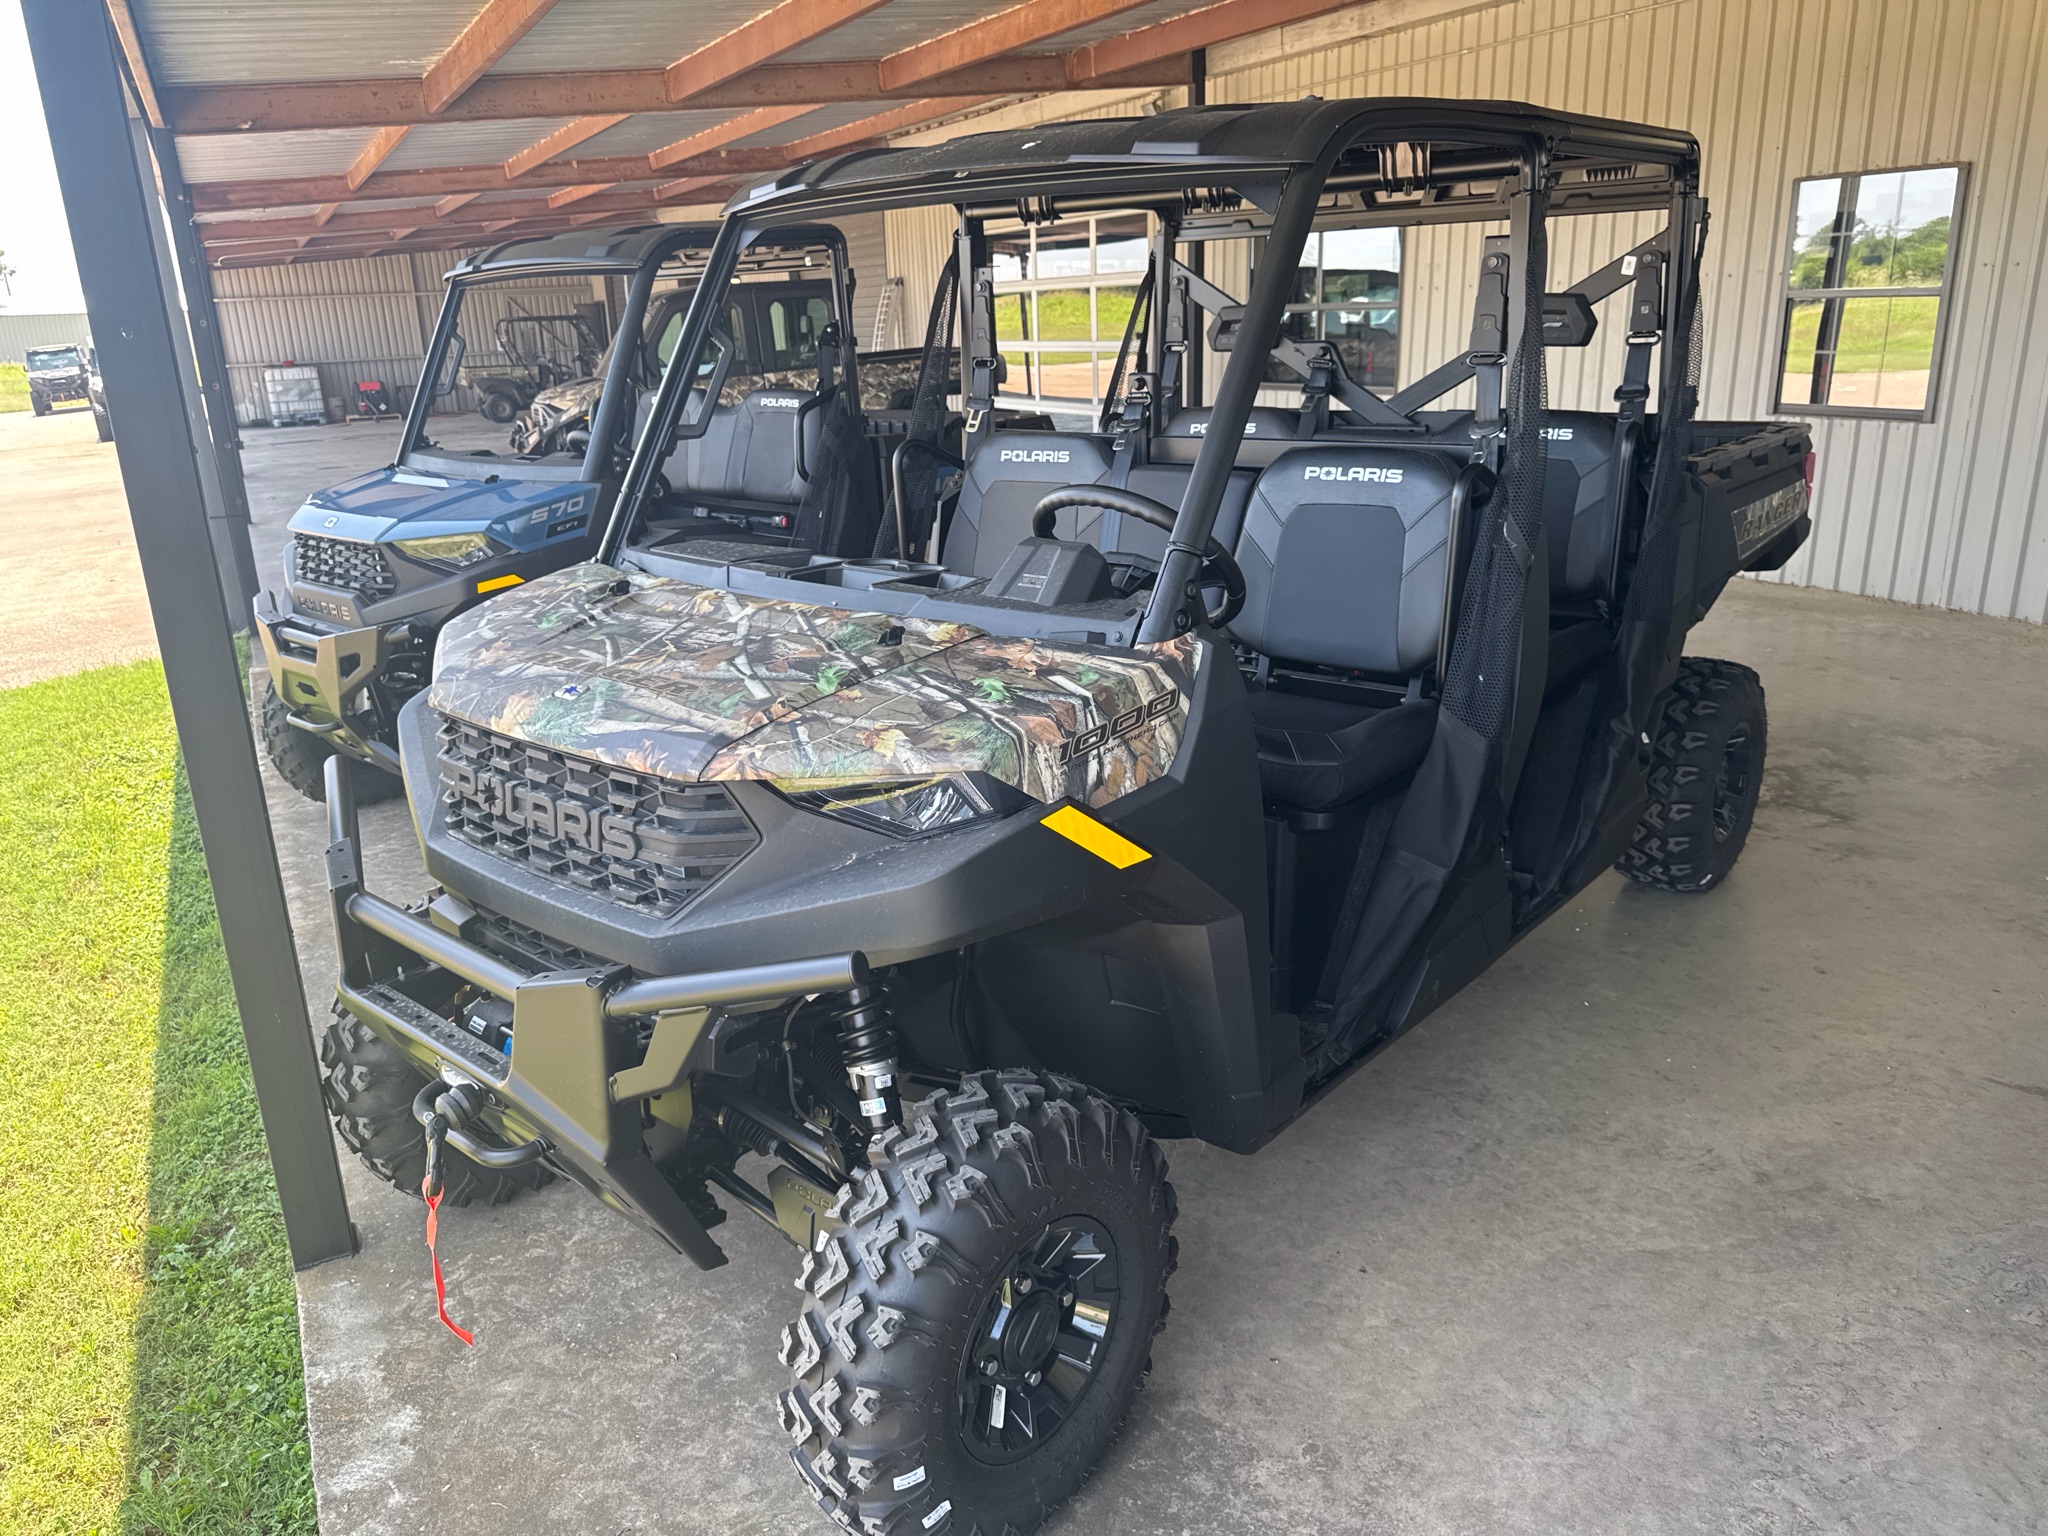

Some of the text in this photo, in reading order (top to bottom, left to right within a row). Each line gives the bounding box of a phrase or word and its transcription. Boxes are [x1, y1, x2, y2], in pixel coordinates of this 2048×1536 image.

[760, 398, 800, 408] POLARIS
[1000, 450, 1070, 463] POLARIS
[1304, 466, 1404, 484] POLARIS
[530, 496, 585, 525] 570
[1738, 489, 1804, 544] RANGER
[557, 520, 578, 532] EFI
[298, 595, 351, 621] POLARIS
[518, 651, 704, 698] RANGER
[1058, 687, 1181, 766] 1000
[457, 763, 642, 861] POLARIS
[787, 1179, 835, 1210] POLA
